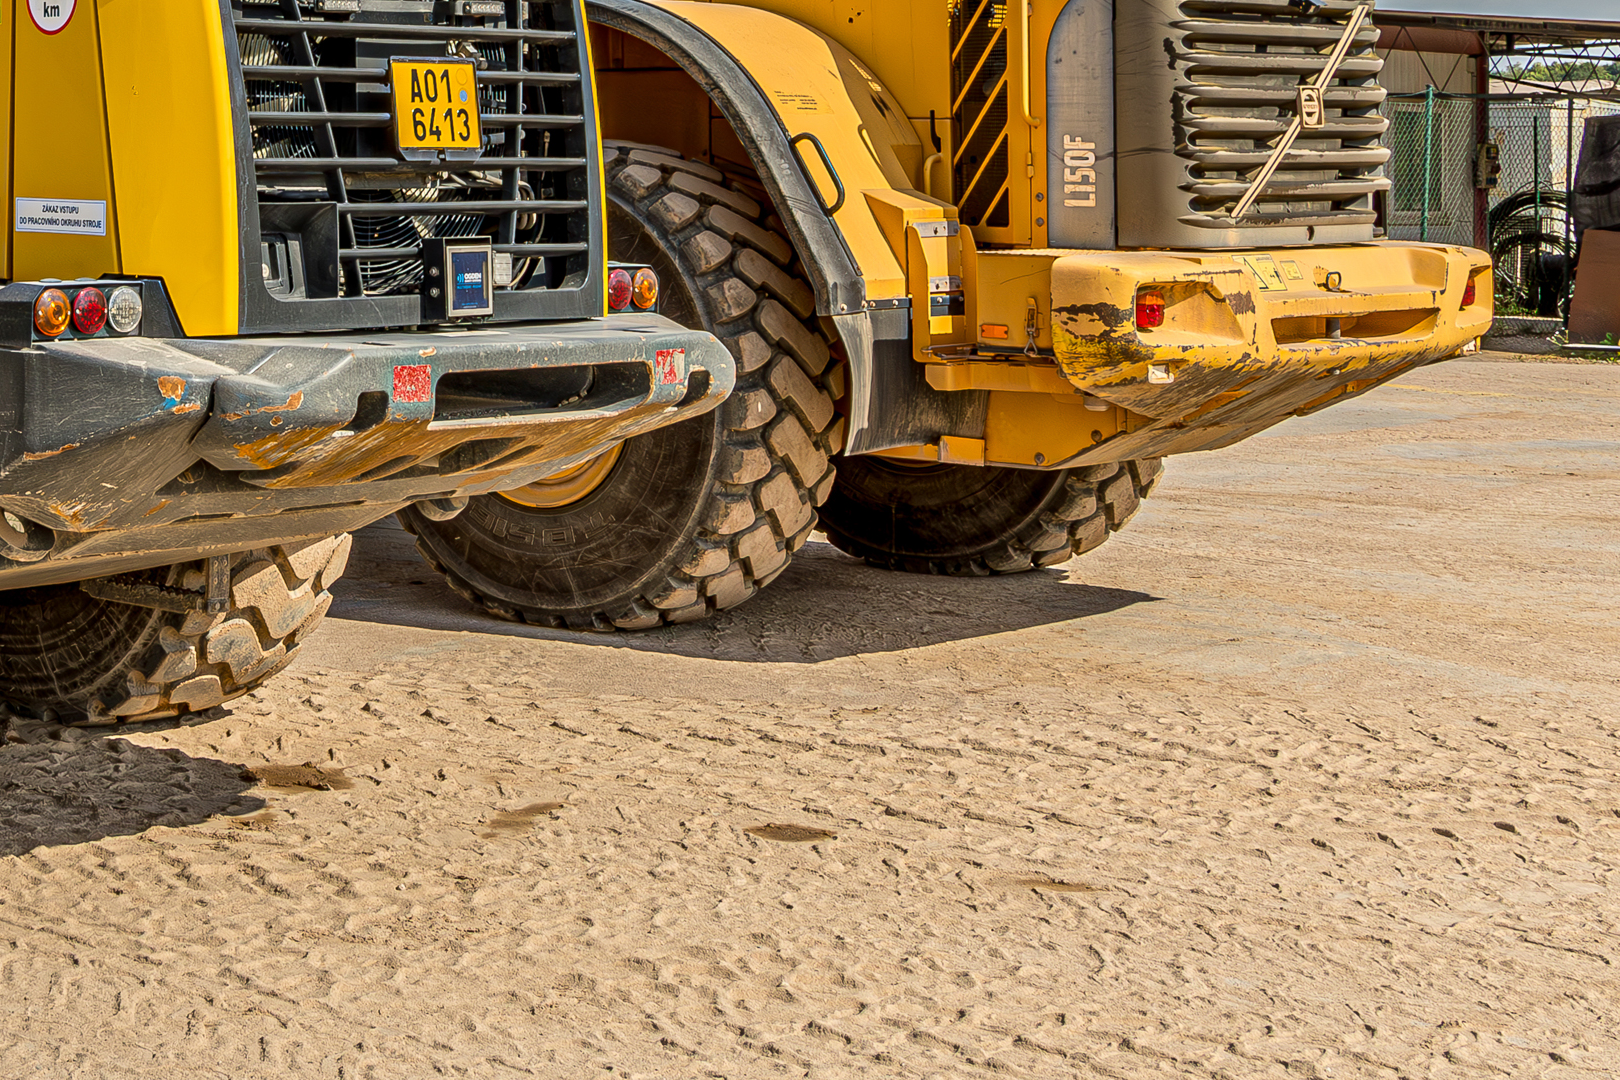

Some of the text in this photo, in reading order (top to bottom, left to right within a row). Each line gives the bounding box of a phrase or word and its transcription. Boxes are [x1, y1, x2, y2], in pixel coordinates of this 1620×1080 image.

[43, 2, 60, 17] km
[410, 68, 453, 103] A01
[412, 107, 471, 142] 6413
[1063, 133, 1096, 208] L150F
[42, 203, 79, 214] ZÁKAZ VSTUPU
[19, 216, 102, 229] DO PRACOVNÍHO OKRUHU STROJE
